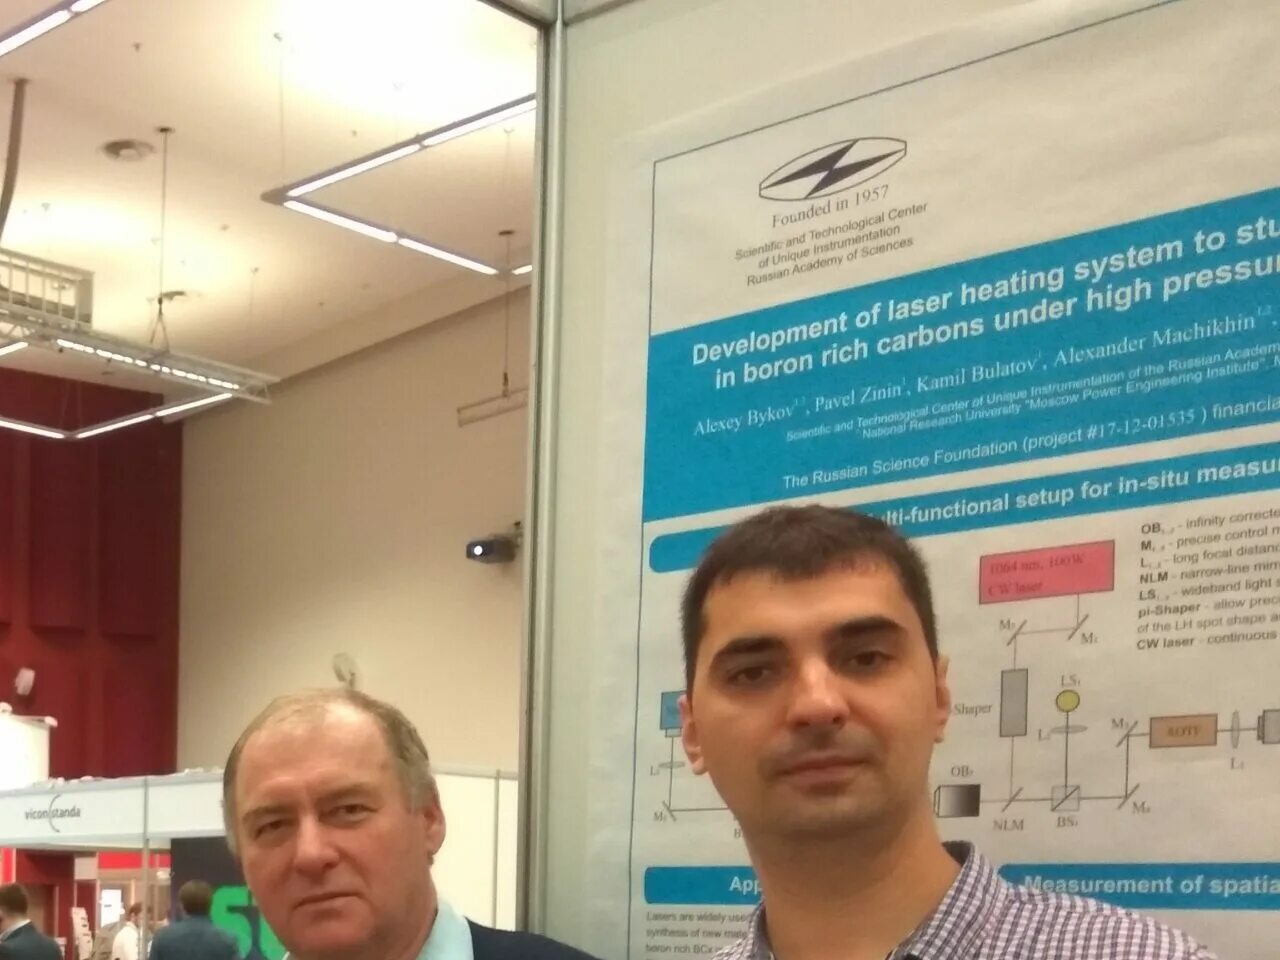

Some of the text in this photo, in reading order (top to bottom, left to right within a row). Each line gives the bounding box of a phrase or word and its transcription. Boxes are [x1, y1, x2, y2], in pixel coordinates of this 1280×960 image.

[735, 202, 928, 261] Scientific and Technological Center
[772, 184, 889, 228] Founded in 1957
[747, 237, 914, 286] Russian Academy of Sciences
[758, 225, 901, 269] of Unique Instrumentation
[692, 215, 1280, 366] Development of laser heating system to stu
[715, 368, 735, 390] in
[743, 353, 813, 383] boron
[821, 338, 868, 367] rich
[877, 316, 984, 355] carbons
[994, 294, 1078, 332] under
[1086, 277, 1152, 312] high
[693, 414, 743, 437] Alexey
[815, 389, 856, 413] Pavel
[916, 367, 966, 394] Kamil
[1053, 335, 1147, 368] Alexander
[834, 420, 854, 435] and
[856, 405, 929, 430] Technological
[931, 400, 964, 415] Center
[970, 396, 984, 409] of
[986, 389, 1027, 406] Unique
[1030, 371, 1125, 398] Instrumentation
[1128, 368, 1142, 381] of
[1144, 363, 1166, 378] the
[1168, 353, 1221, 372] Russian
[909, 413, 963, 432] Research
[965, 402, 1021, 422] University
[1082, 385, 1122, 402] Power
[1125, 369, 1203, 394] Engineering
[783, 473, 809, 490] The
[812, 464, 868, 484] Russian
[872, 454, 929, 475] Science
[934, 438, 1018, 466] Foundation
[1022, 428, 1082, 451] (project
[1086, 406, 1195, 440] #17-12-01535
[880, 458, 1280, 527] lti-functional setup for in-situ measu
[1225, 525, 1268, 541] control
[1139, 571, 1168, 585] NLM
[1024, 875, 1173, 894] Measurement
[1180, 874, 1204, 894] of
